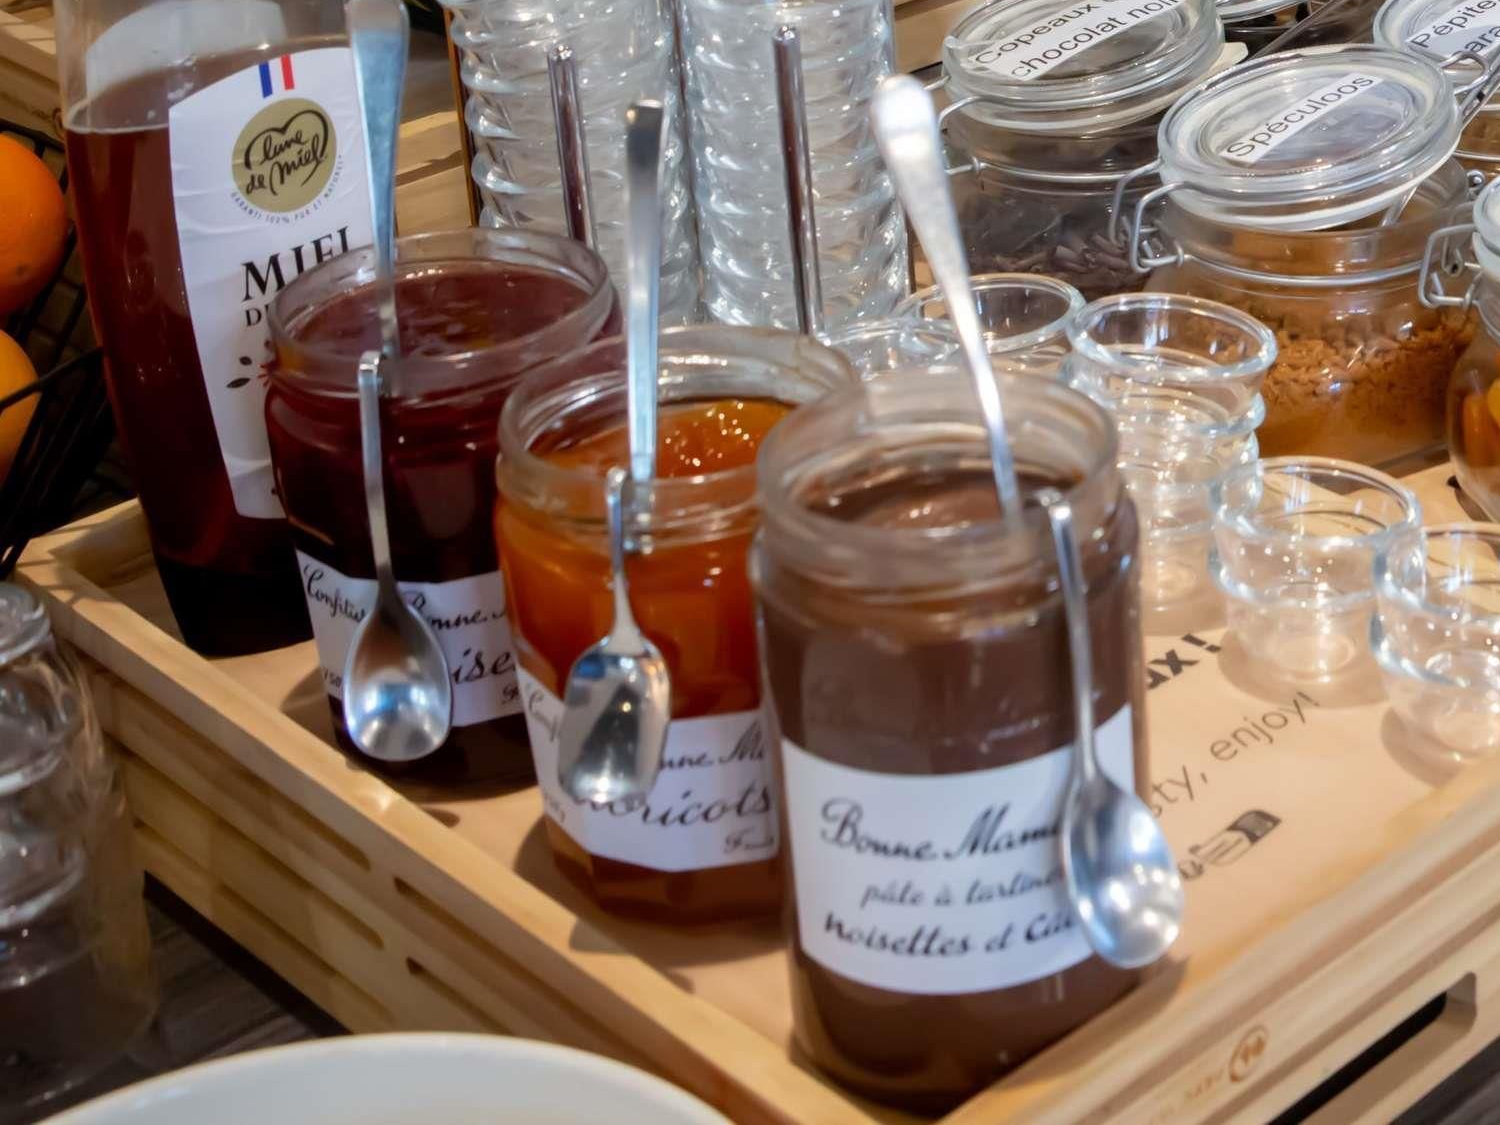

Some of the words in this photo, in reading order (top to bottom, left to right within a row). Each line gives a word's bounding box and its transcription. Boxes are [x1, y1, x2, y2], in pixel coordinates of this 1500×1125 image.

[975, 2, 1101, 65] Copeaux
[1012, 15, 1128, 77] chocolat
[260, 129, 311, 165] lune
[1224, 73, 1376, 159] Spéculoos
[245, 173, 268, 196] de
[269, 132, 323, 197] miel
[1149, 764, 1208, 819] sty,
[1209, 691, 1320, 761] enjoy!
[820, 796, 938, 862] Bonne
[860, 879, 924, 910] pâte
[934, 880, 955, 907] à
[983, 923, 1013, 954] et
